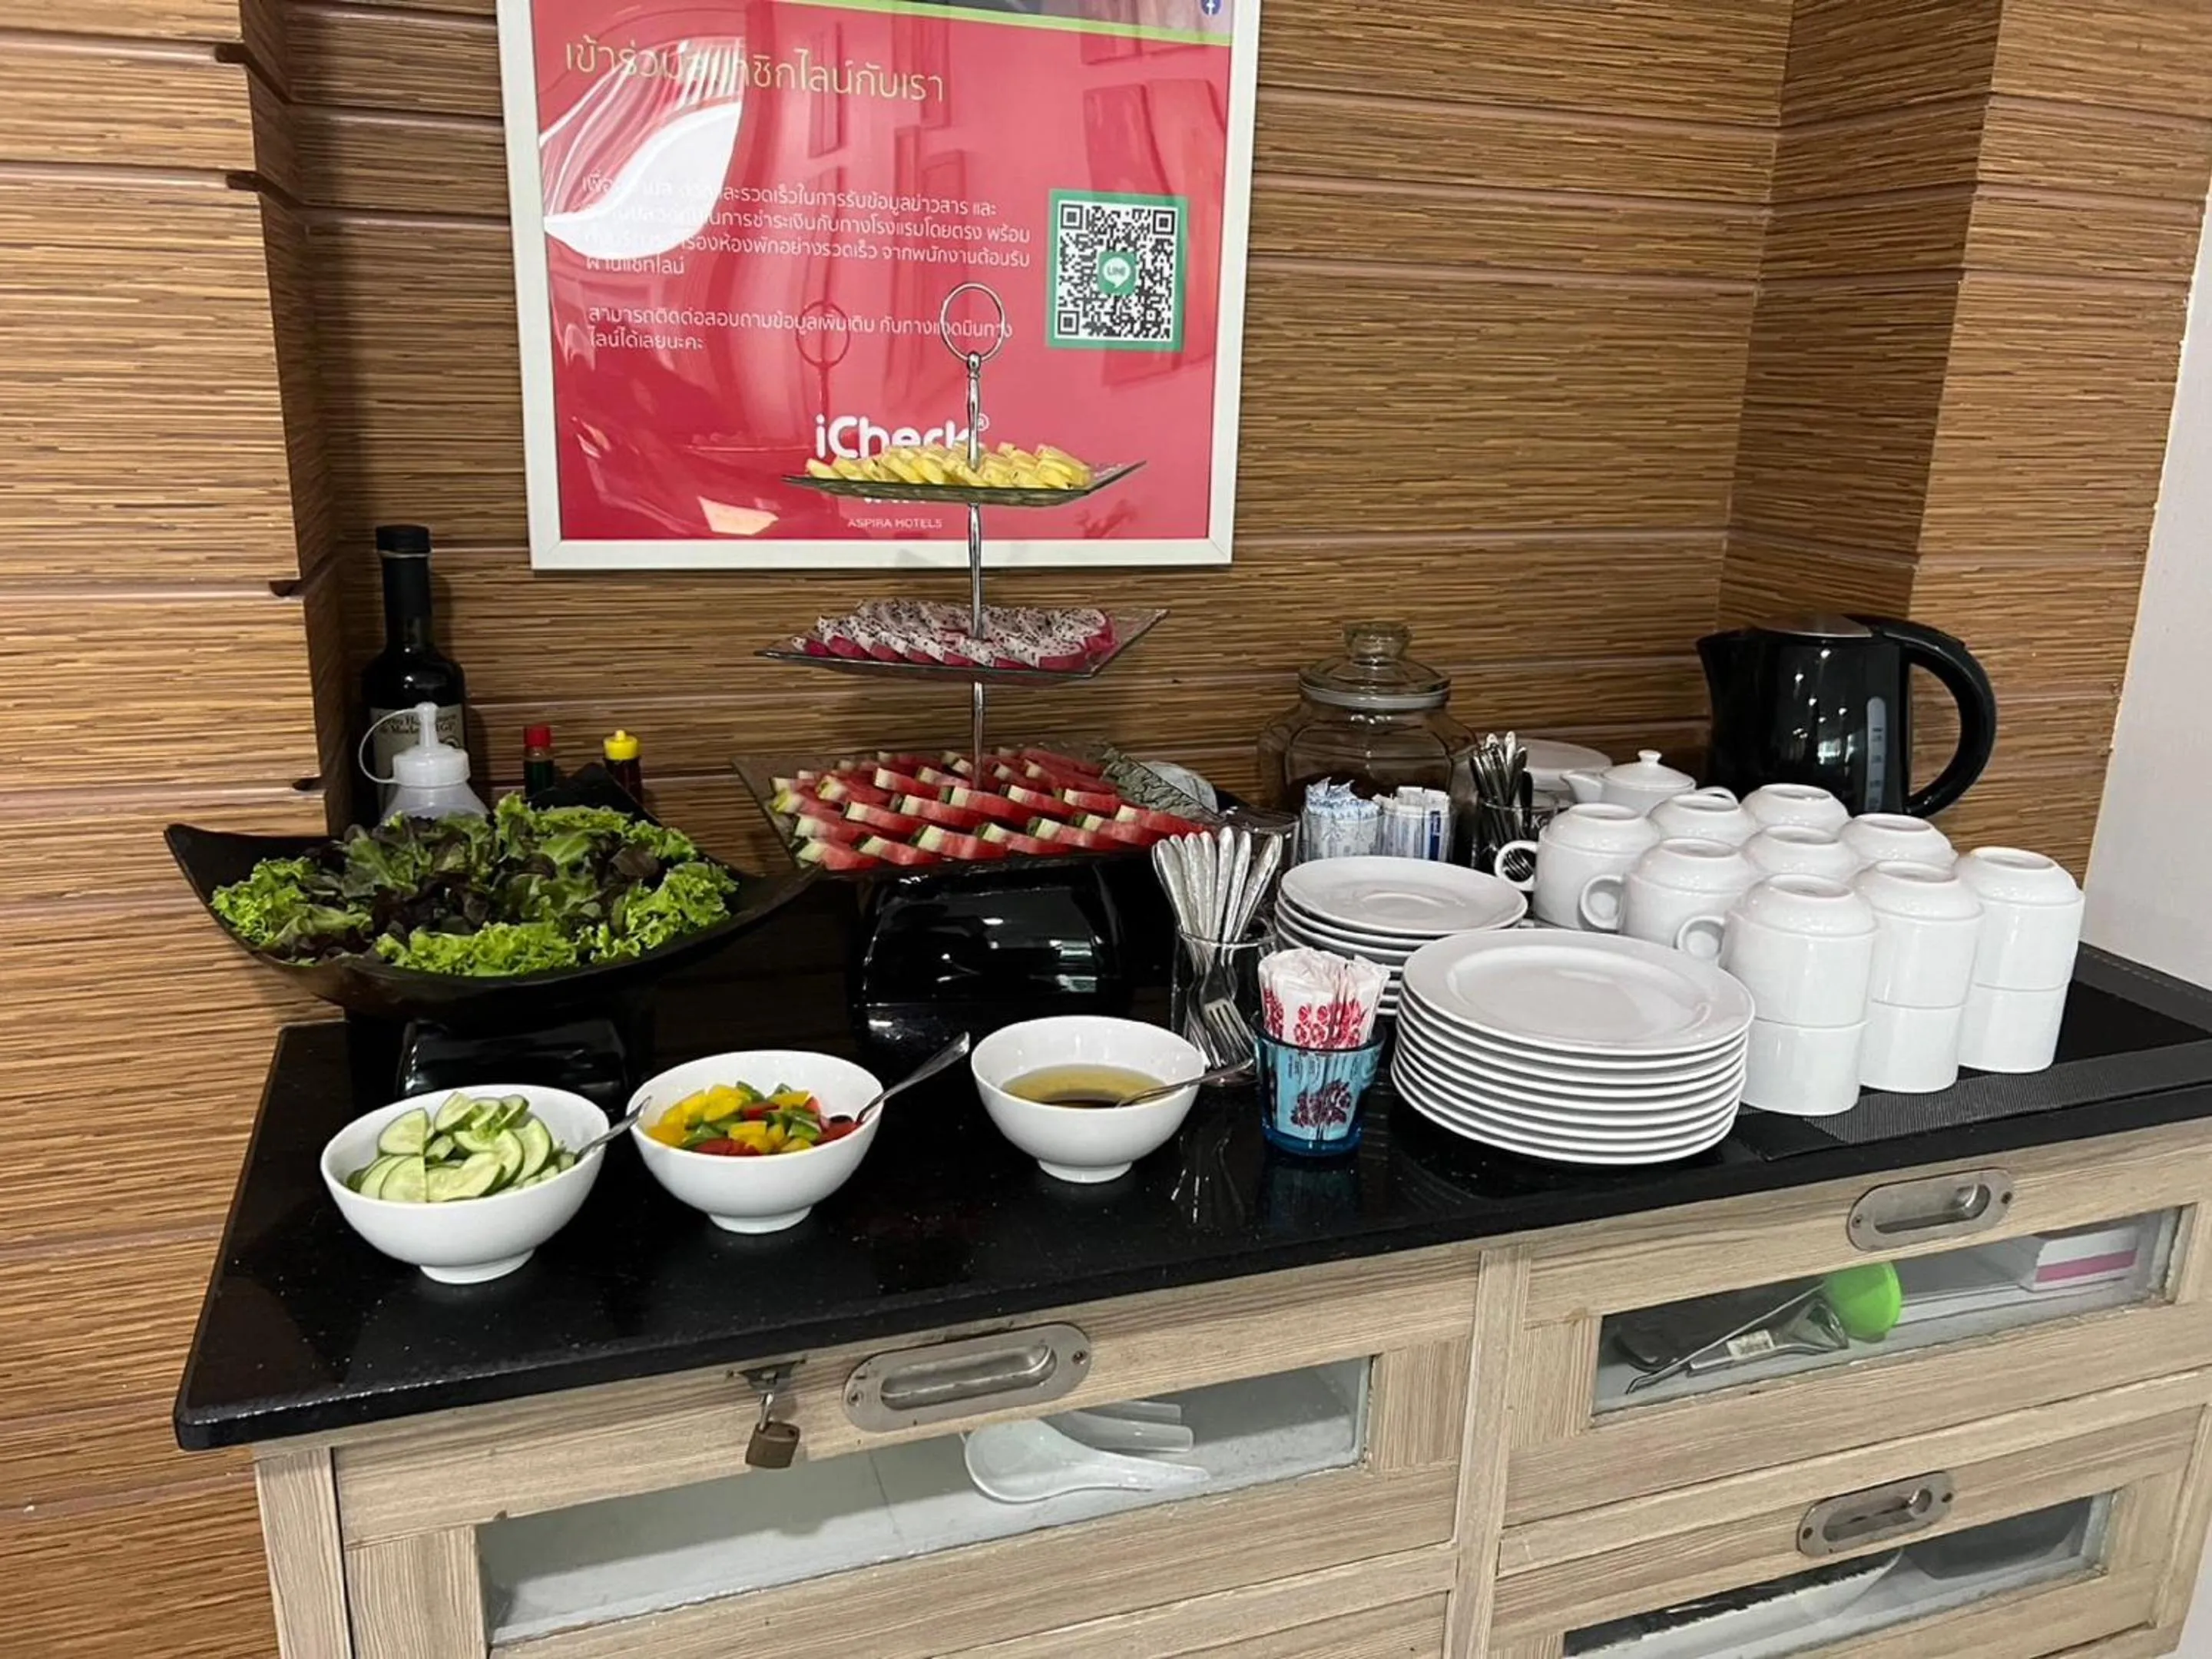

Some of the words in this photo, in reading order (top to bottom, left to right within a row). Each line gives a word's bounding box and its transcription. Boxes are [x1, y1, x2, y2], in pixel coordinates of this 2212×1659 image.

[972, 202, 997, 216] และ
[987, 224, 1031, 243] พร้อม
[882, 244, 1031, 267] จากพนักงานต้อนรับ
[588, 325, 705, 350] ไลน์ได้เลยนะคะ
[847, 518, 892, 529] ASPIRA
[895, 518, 943, 529] HOTELS
